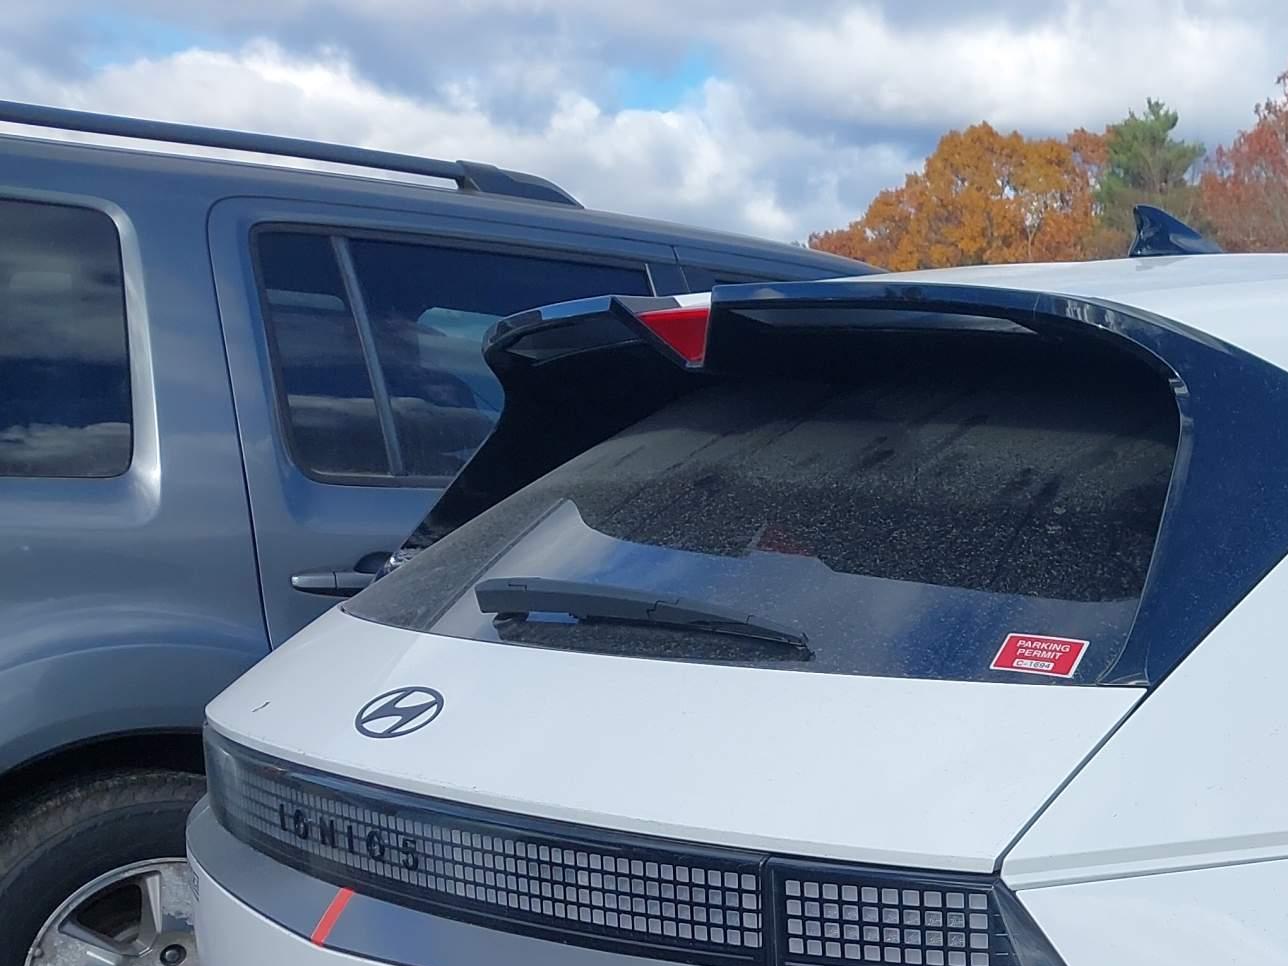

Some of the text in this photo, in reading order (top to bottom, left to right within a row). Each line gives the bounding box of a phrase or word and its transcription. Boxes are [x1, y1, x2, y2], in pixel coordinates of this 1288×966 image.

[1017, 640, 1071, 652] PARKING
[1017, 648, 1063, 660] PERMIT
[402, 838, 418, 870] 5
